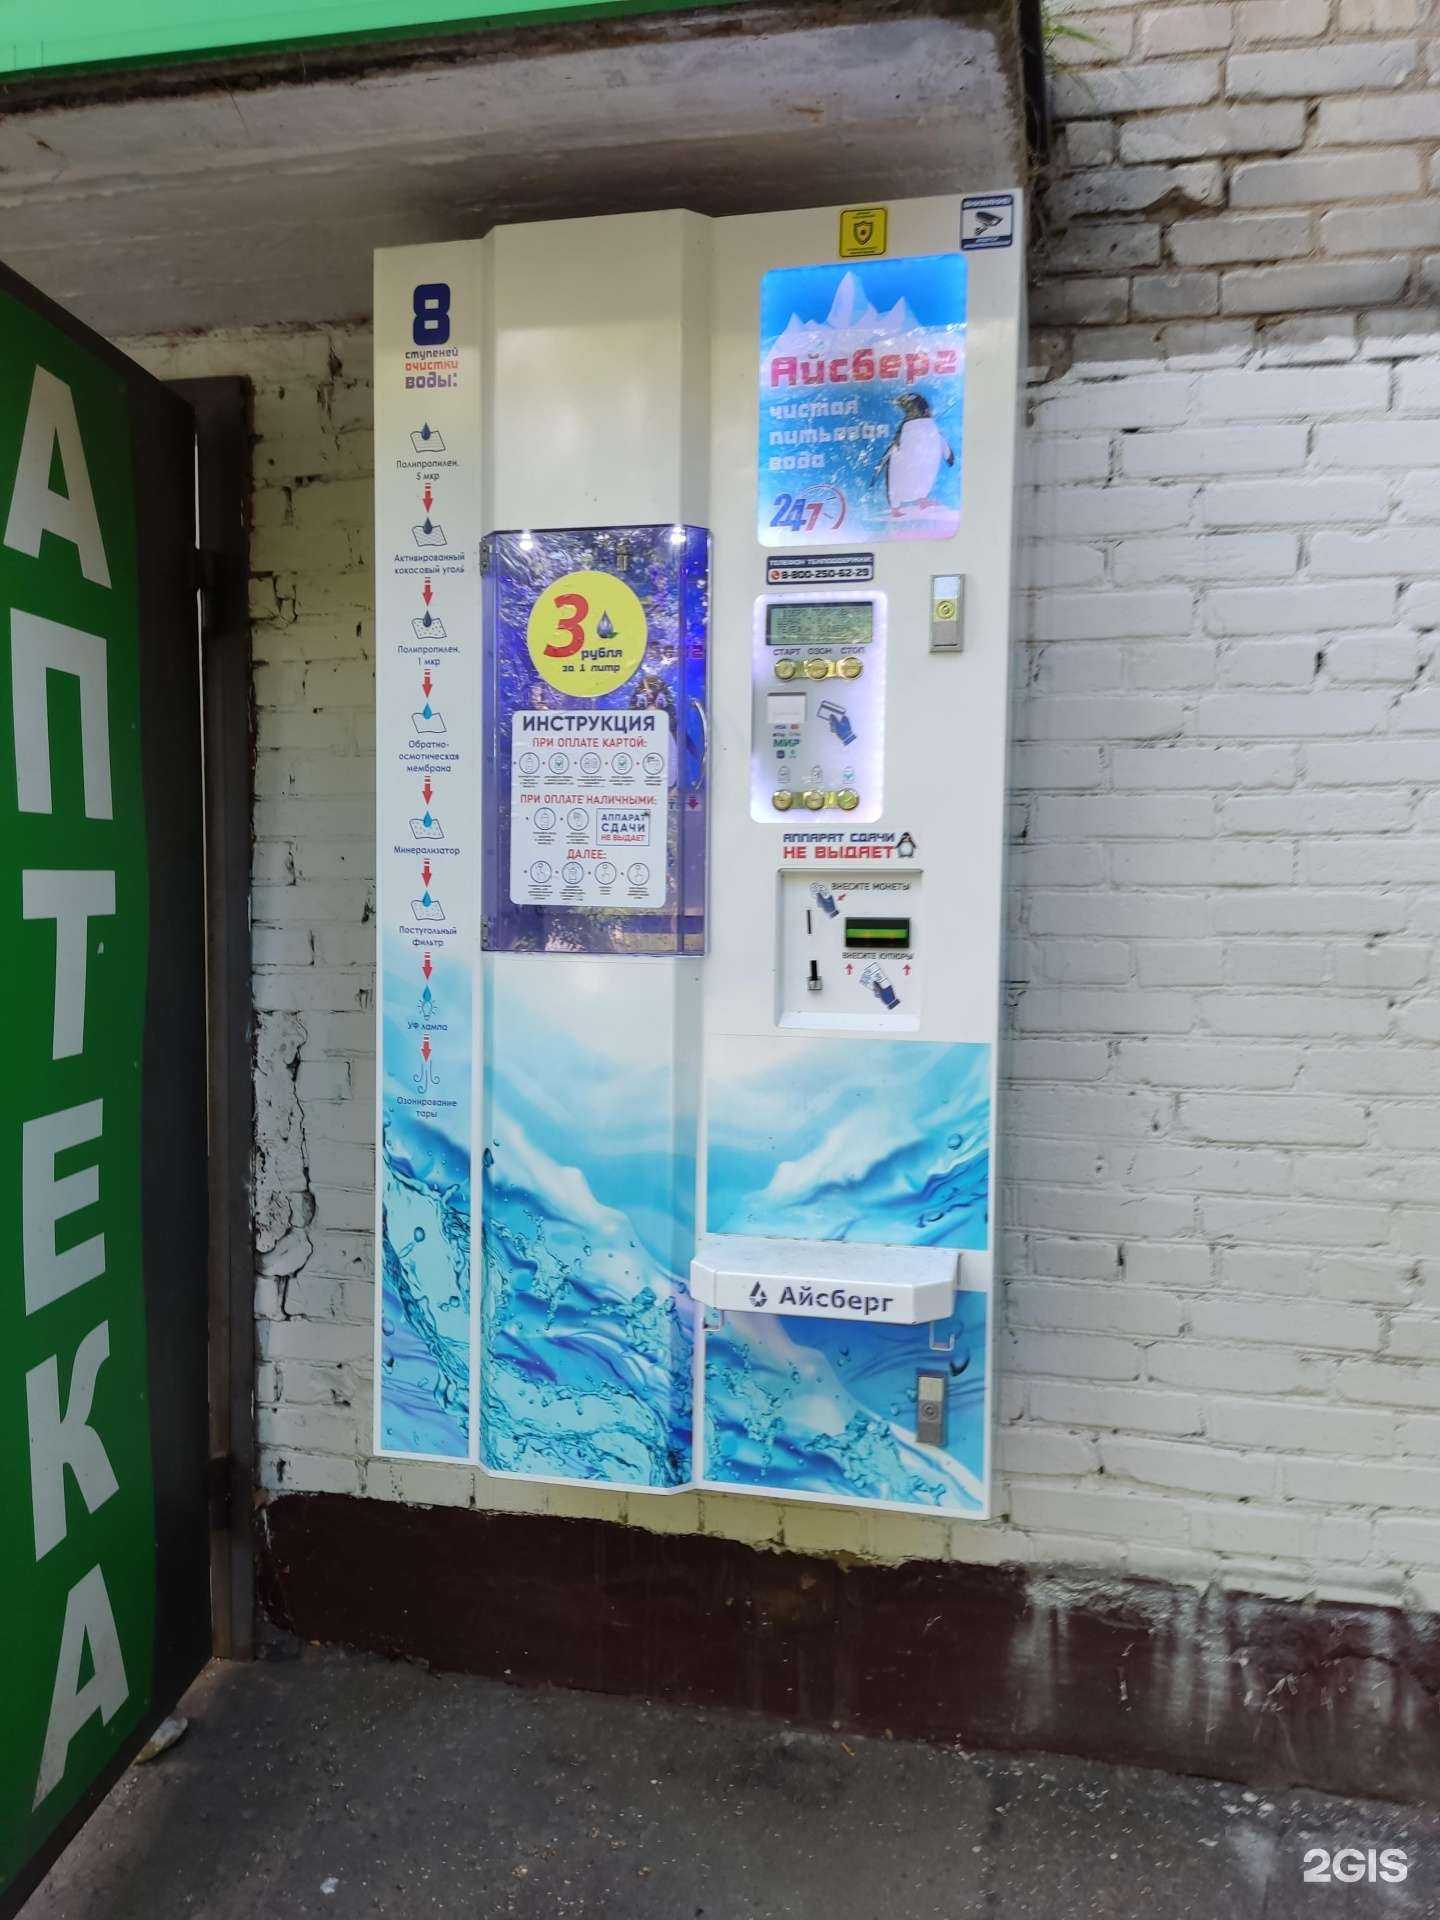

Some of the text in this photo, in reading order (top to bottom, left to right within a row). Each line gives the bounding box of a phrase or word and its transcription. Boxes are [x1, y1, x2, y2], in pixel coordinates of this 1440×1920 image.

[412, 283, 451, 346] 8
[404, 346, 459, 361] ступеней
[404, 360, 459, 372] очистки
[770, 347, 958, 388] Айсберг
[404, 371, 458, 390] воды:
[768, 399, 860, 420] чистая
[768, 422, 890, 446] питьевая
[767, 451, 826, 471] вода
[415, 471, 440, 481] 5 мкр
[393, 552, 465, 563] Активированный
[394, 564, 465, 575] кокосовый уголь
[543, 592, 590, 658] 3
[580, 646, 624, 661] рубля
[423, 658, 441, 666] мкр
[561, 663, 621, 674] за 1 литр
[522, 715, 656, 734] ИНСТРУКЦИЯ
[408, 740, 450, 750] Обратно-
[532, 735, 649, 749] ПРИ ОПЛАТЕ КАРТОЙ:
[398, 752, 460, 761] осмотическая
[406, 763, 452, 773] мембрана
[520, 794, 657, 806] ПРИ ОПЛАТЕ НАЛИЧНЫМИ:
[600, 813, 646, 823] АППАРАТ
[600, 824, 646, 834] СДАЧИ
[600, 834, 646, 842] НЕ ВЫДАЕТ
[782, 831, 896, 843] АППАРАТ СДАЧИ
[393, 845, 461, 856] Минерализатор
[566, 848, 607, 861] ДАЛЕЕ:
[783, 845, 895, 860] НЕ ВЫДАЕТ
[831, 882, 871, 891] ВНЕСИТЕ
[399, 925, 457, 936] Постугольный
[841, 951, 877, 960] ВНЕСИТЕ
[420, 1023, 449, 1032] лампа
[3, 363, 130, 1813] АПТЕКА
[396, 1096, 458, 1108] Озонирование
[416, 1110, 438, 1119] тары
[778, 1285, 895, 1316] Айсберг
